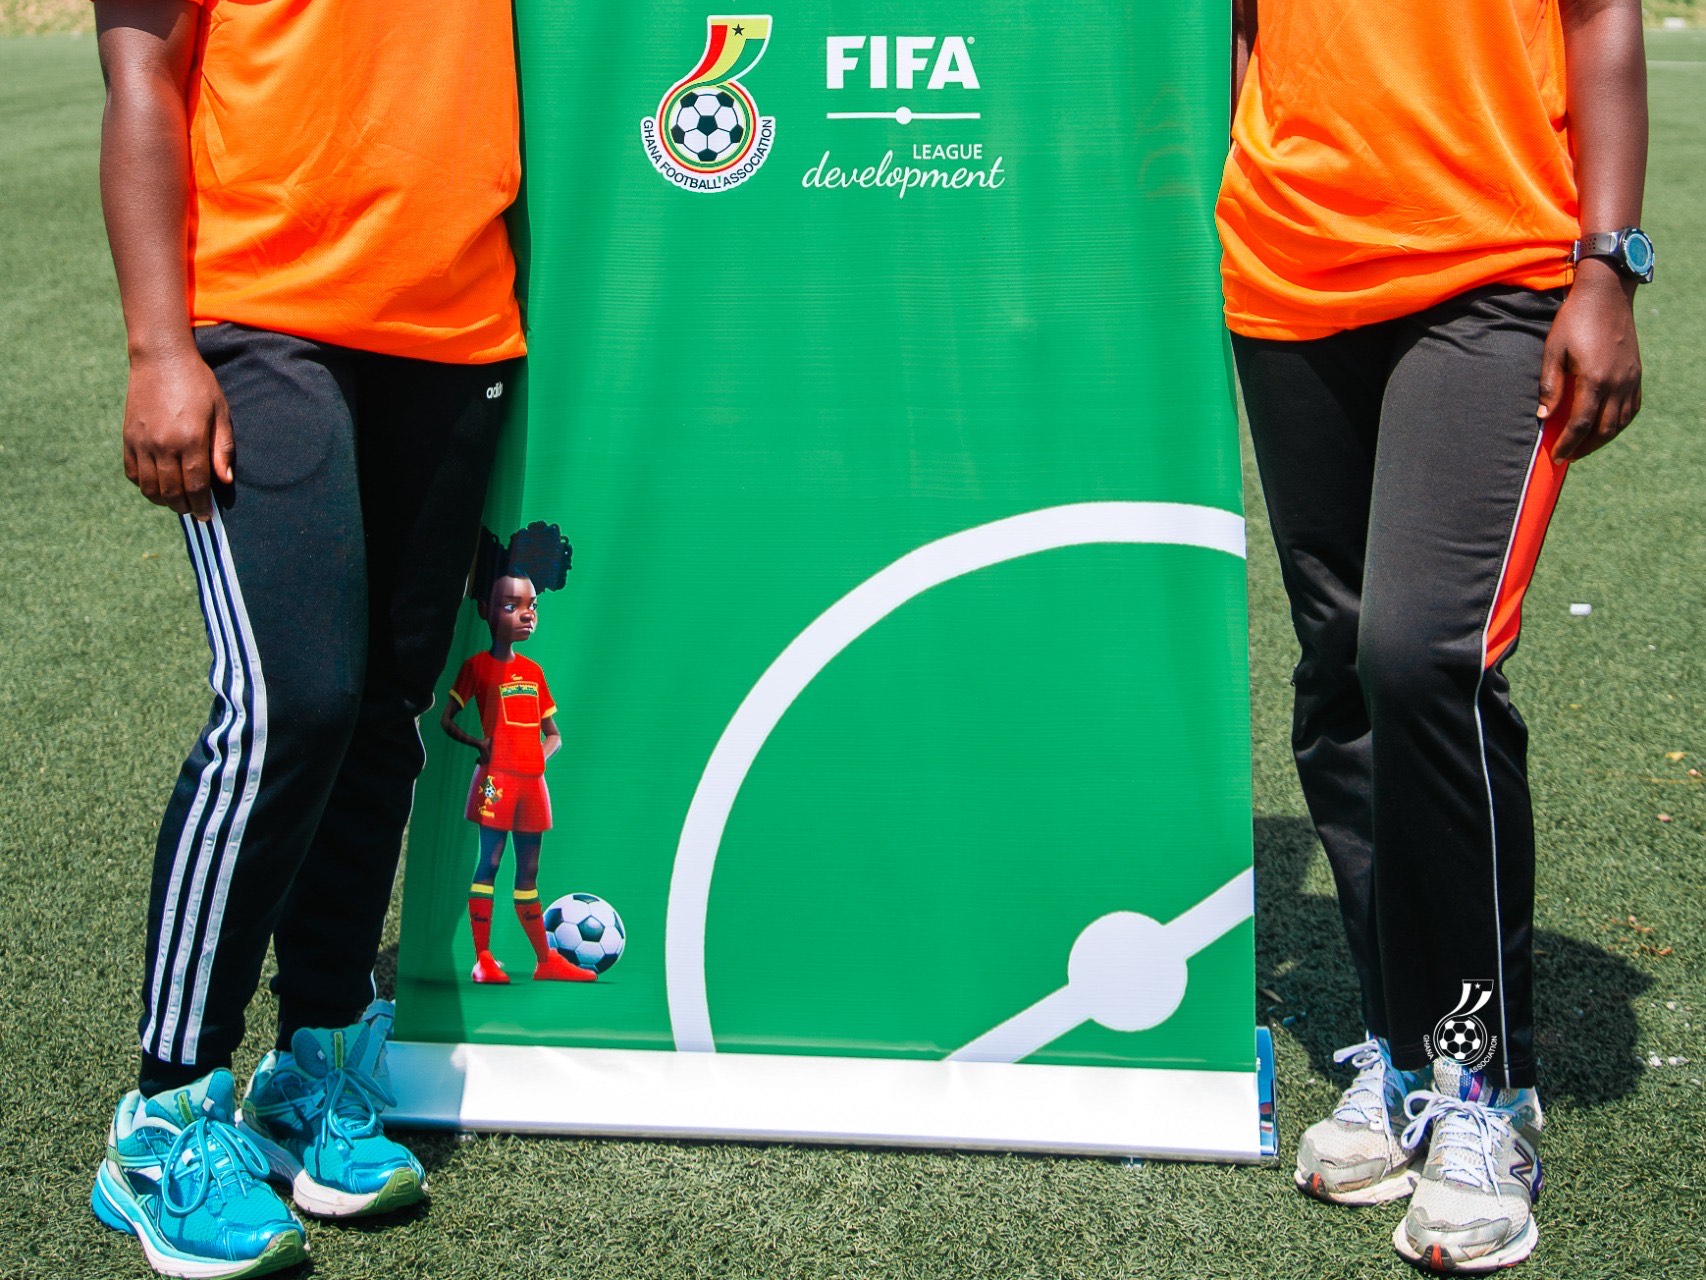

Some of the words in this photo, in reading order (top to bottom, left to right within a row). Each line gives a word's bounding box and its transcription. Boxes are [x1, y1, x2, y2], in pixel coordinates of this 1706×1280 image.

[826, 35, 980, 90] FIFA
[643, 119, 663, 164] GHANA
[659, 161, 721, 190] FOOTBALL
[722, 118, 773, 187] ASSOCIATION
[801, 150, 1005, 199] development
[912, 143, 983, 160] LEAGUE
